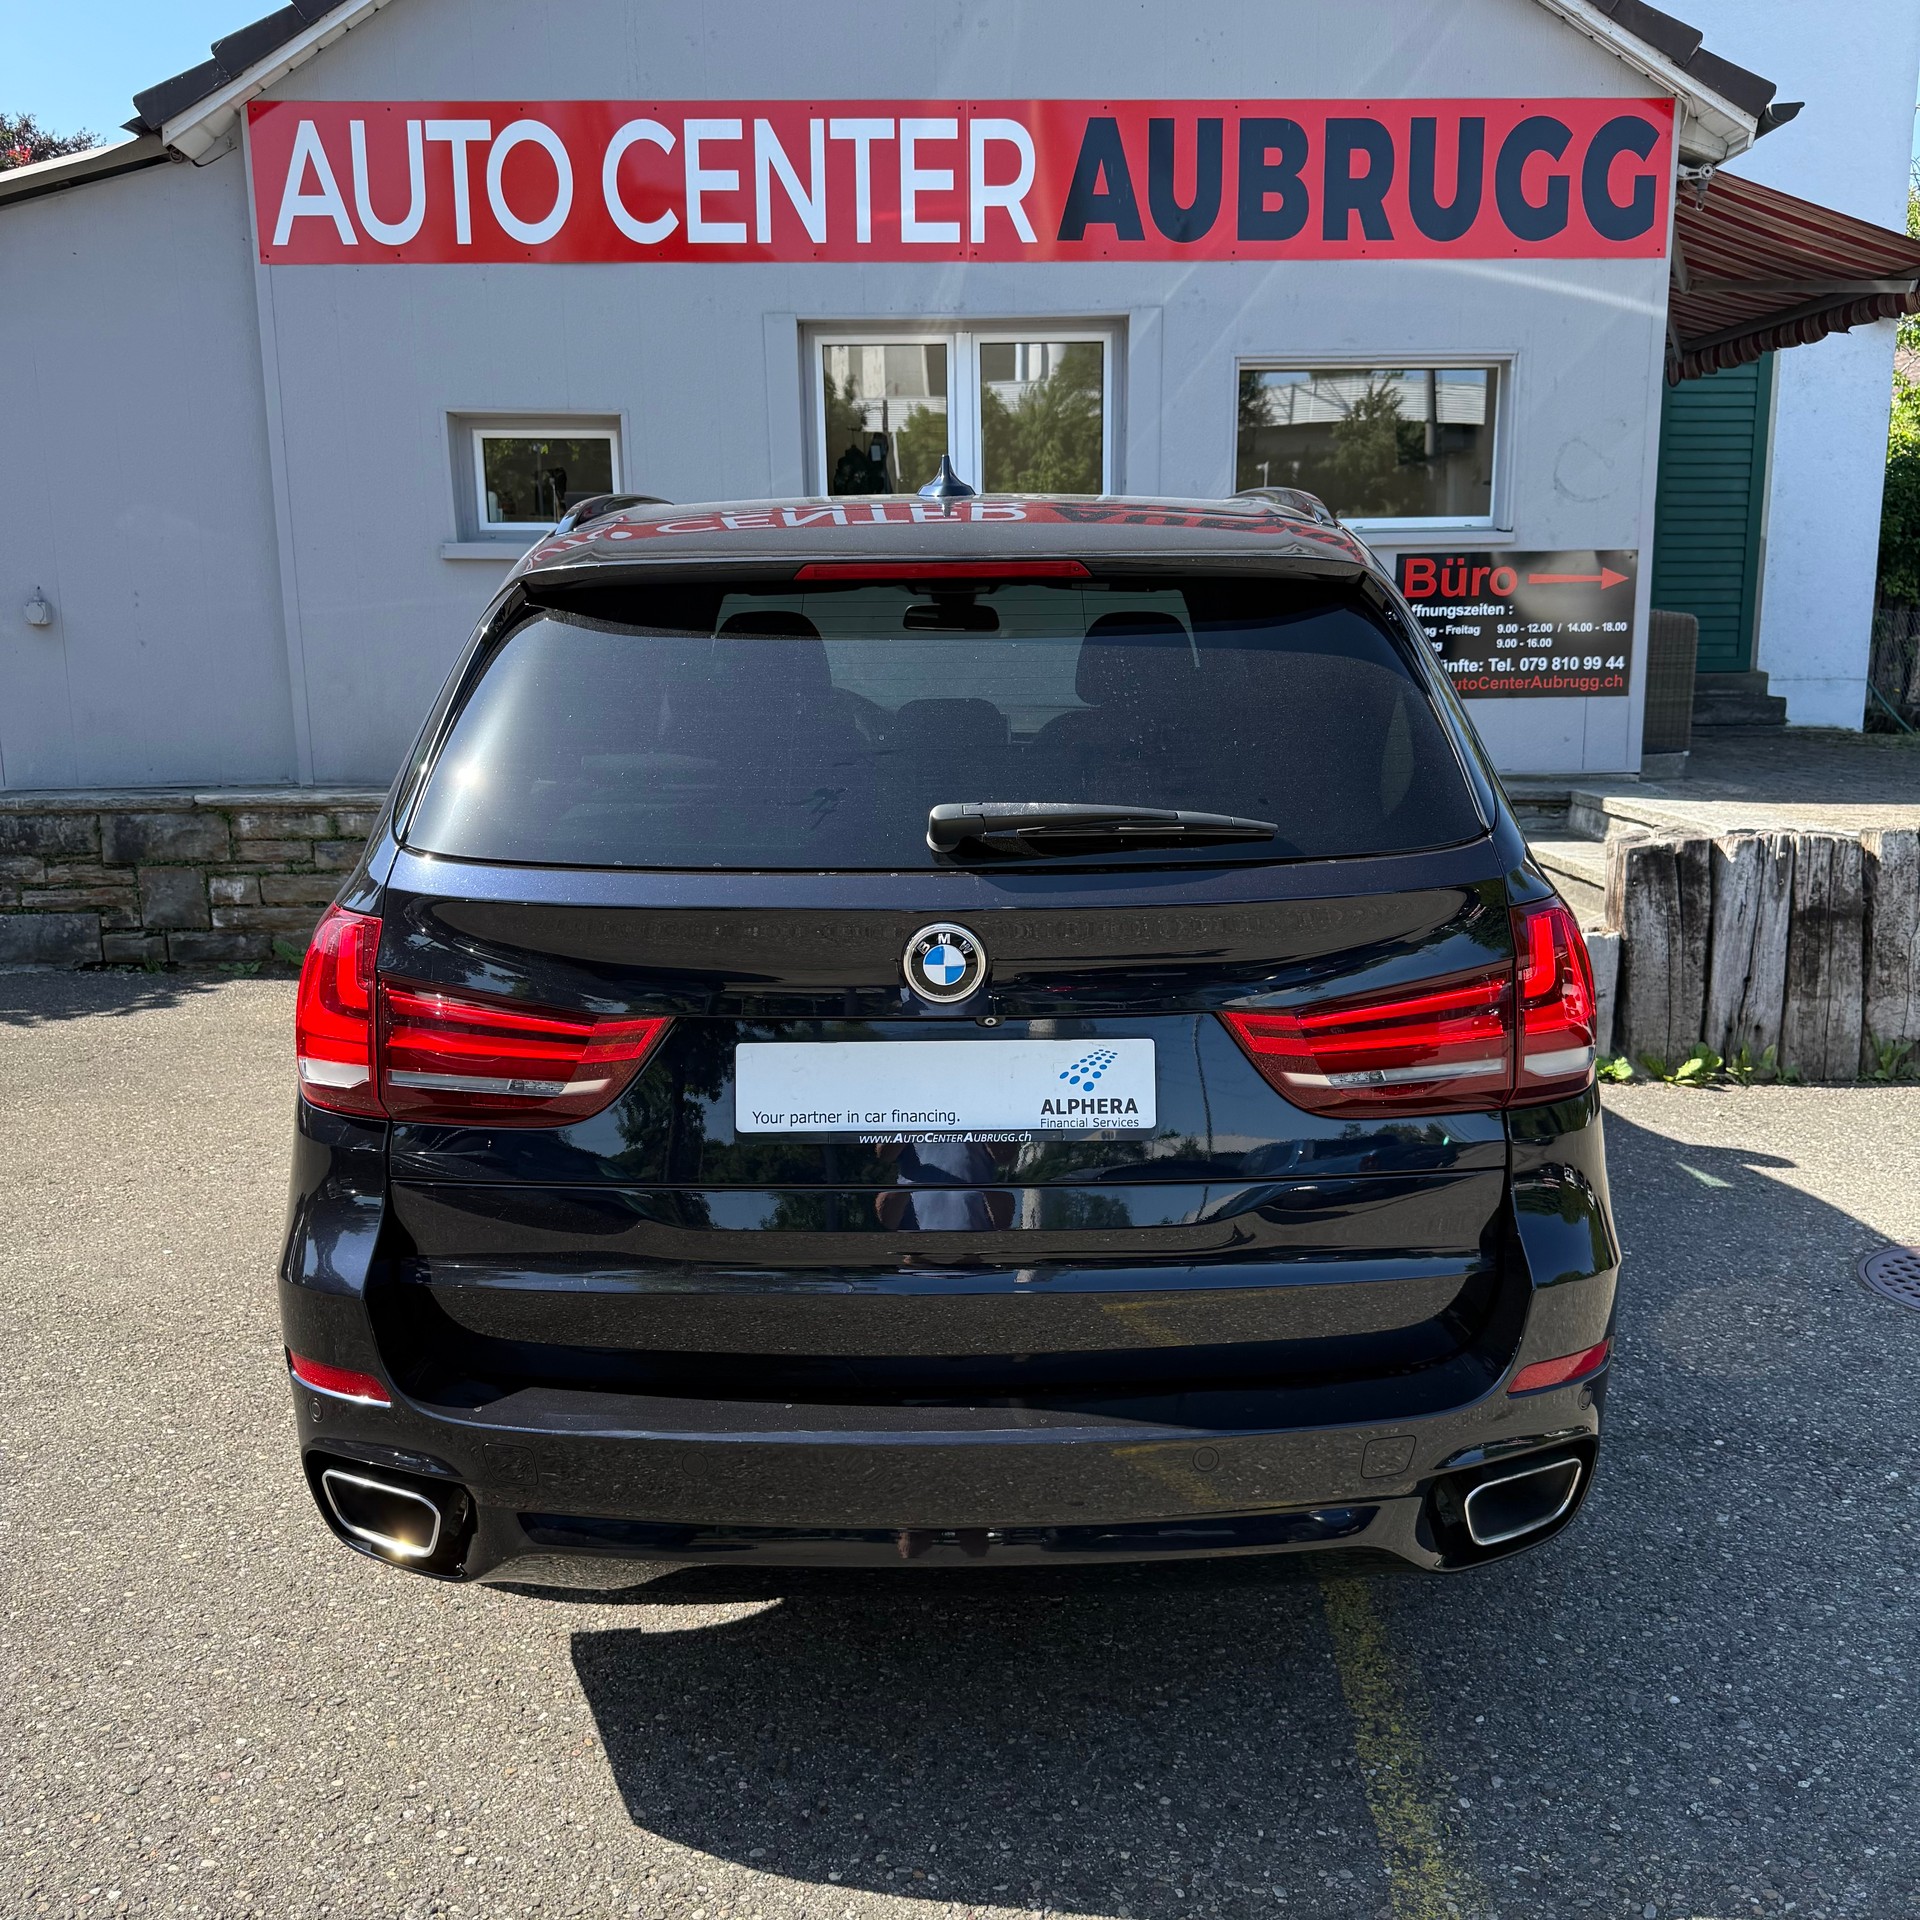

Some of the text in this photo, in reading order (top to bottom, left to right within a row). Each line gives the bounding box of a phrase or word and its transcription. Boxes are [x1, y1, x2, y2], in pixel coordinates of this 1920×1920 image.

[272, 114, 1661, 246] AUTO CENTER AUBRUGG
[1403, 557, 1518, 598] Büro
[1411, 602, 1505, 619] ffnungszeiten
[1445, 624, 1481, 637] Freitag
[1497, 623, 1518, 634] 9.00
[1527, 623, 1553, 633] 12.00
[1567, 622, 1593, 632] 14.00
[1602, 621, 1628, 632] 18.00
[1496, 638, 1518, 648] 9.00
[1526, 638, 1553, 648] 16.00
[1488, 658, 1516, 672] Tel.
[1520, 656, 1548, 672] 079
[1552, 656, 1579, 671] 810
[1583, 655, 1602, 670] 99
[1605, 655, 1625, 670] 44
[1452, 674, 1623, 691] utoCenterAubrugg.ch
[917, 933, 973, 955] BMW
[1040, 1098, 1139, 1115] ALPHERA
[752, 1109, 961, 1127] Your partner in car financing.
[1040, 1116, 1140, 1128] Financial Services
